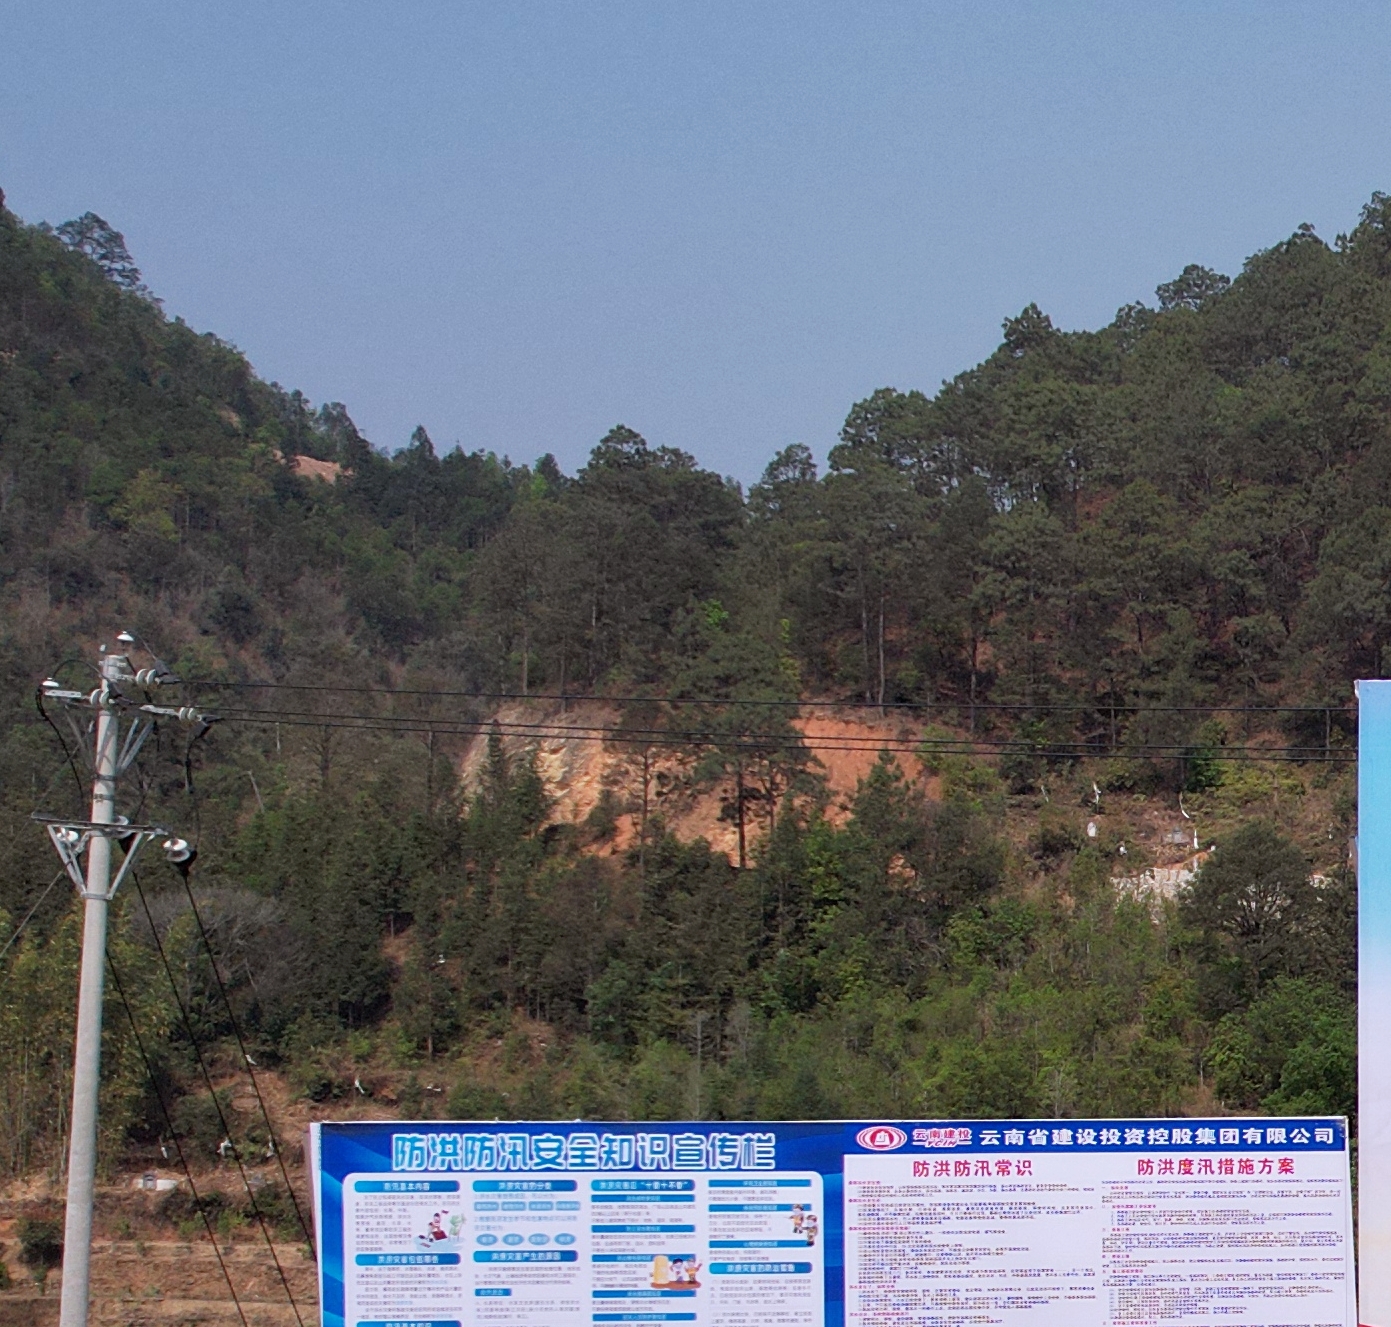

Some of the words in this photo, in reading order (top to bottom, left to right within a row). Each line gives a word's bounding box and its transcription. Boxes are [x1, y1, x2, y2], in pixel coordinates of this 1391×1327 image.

[979, 1127, 1334, 1146] 云南省建设投资控股集团有限公司
[392, 1133, 776, 1171] 防洪防汛安全知识宣传栏
[912, 1159, 1033, 1177] 防洪防汛常识
[1137, 1157, 1295, 1175] 防洪度汛措施方案
